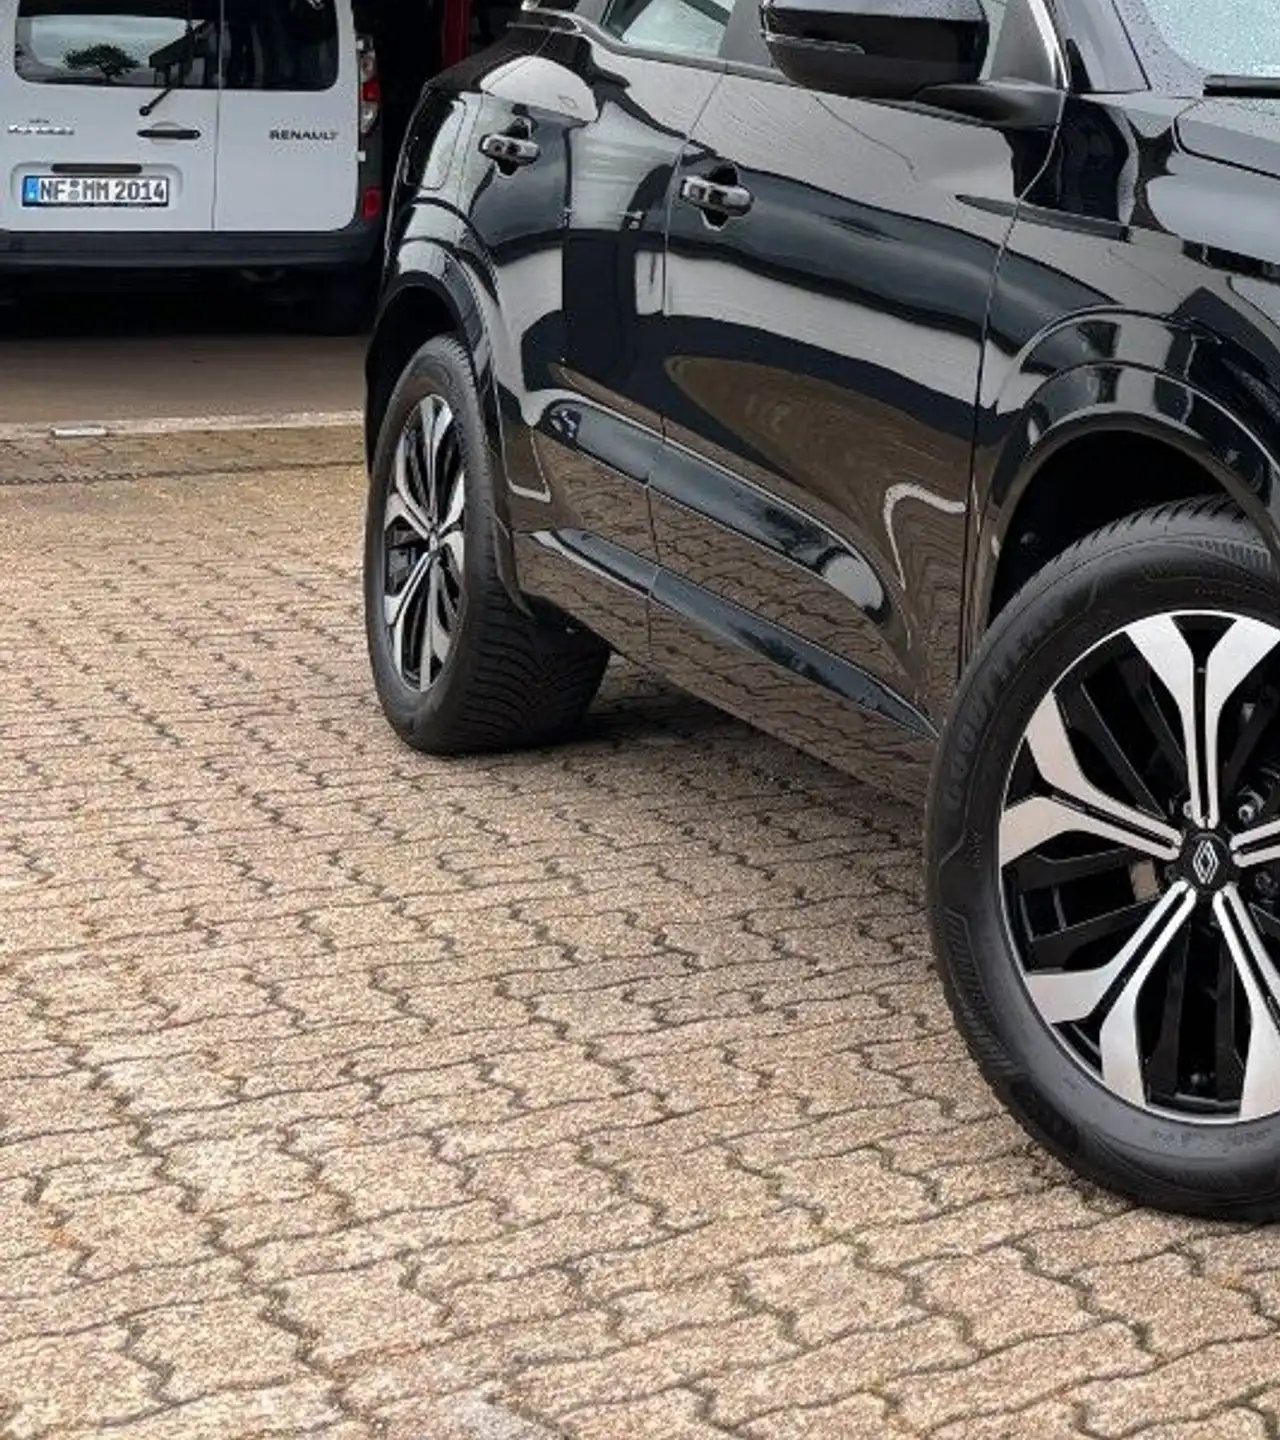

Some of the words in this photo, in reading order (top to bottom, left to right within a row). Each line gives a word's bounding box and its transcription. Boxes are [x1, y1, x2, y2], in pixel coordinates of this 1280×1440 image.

[269, 129, 339, 141] RENAULT
[40, 179, 65, 201] NF
[115, 181, 165, 201] 2014
